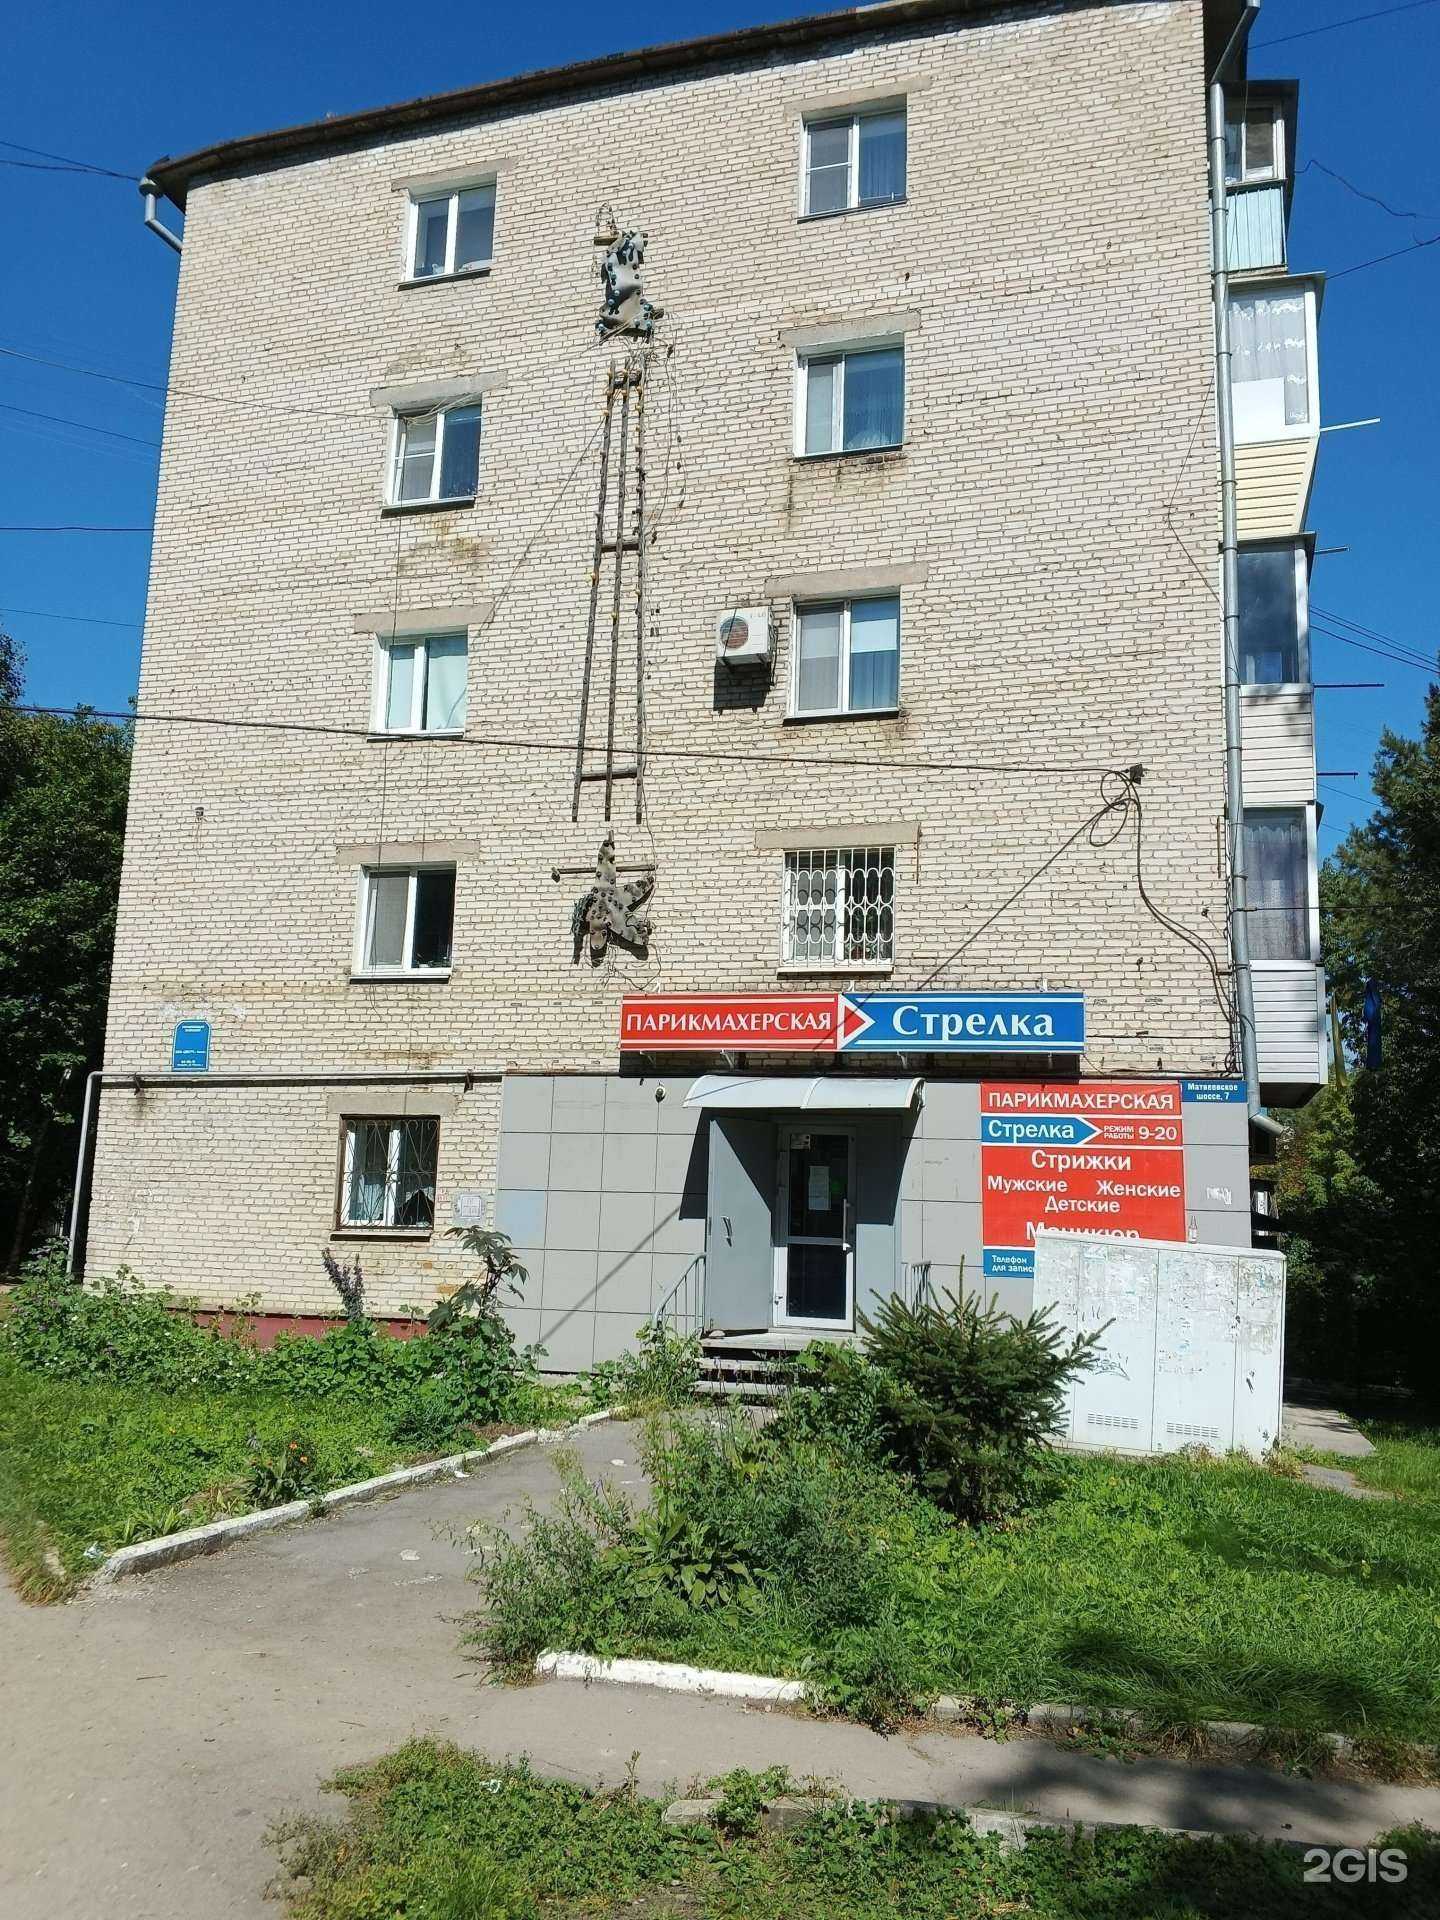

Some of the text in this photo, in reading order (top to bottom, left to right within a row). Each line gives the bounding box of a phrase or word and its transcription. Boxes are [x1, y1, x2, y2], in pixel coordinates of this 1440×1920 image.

[626, 1005, 1055, 1041] ПАРИКМАХЕРСКАЯ Стрелка
[988, 1092, 1173, 1110] ПАРИКМАХЕРСКАЯ
[1224, 1092, 1230, 1100] 7
[988, 1120, 1074, 1143] Стрелка
[1103, 1125, 1134, 1133] РЕЖИМ
[1103, 1132, 1135, 1140] РАБОТЫ
[1138, 1126, 1178, 1140] 9-20
[1031, 1150, 1131, 1172] Стрижки
[987, 1175, 1181, 1198] Мужские Женские
[1044, 1196, 1121, 1213] Детские
[992, 1254, 1027, 1264] Телефон
